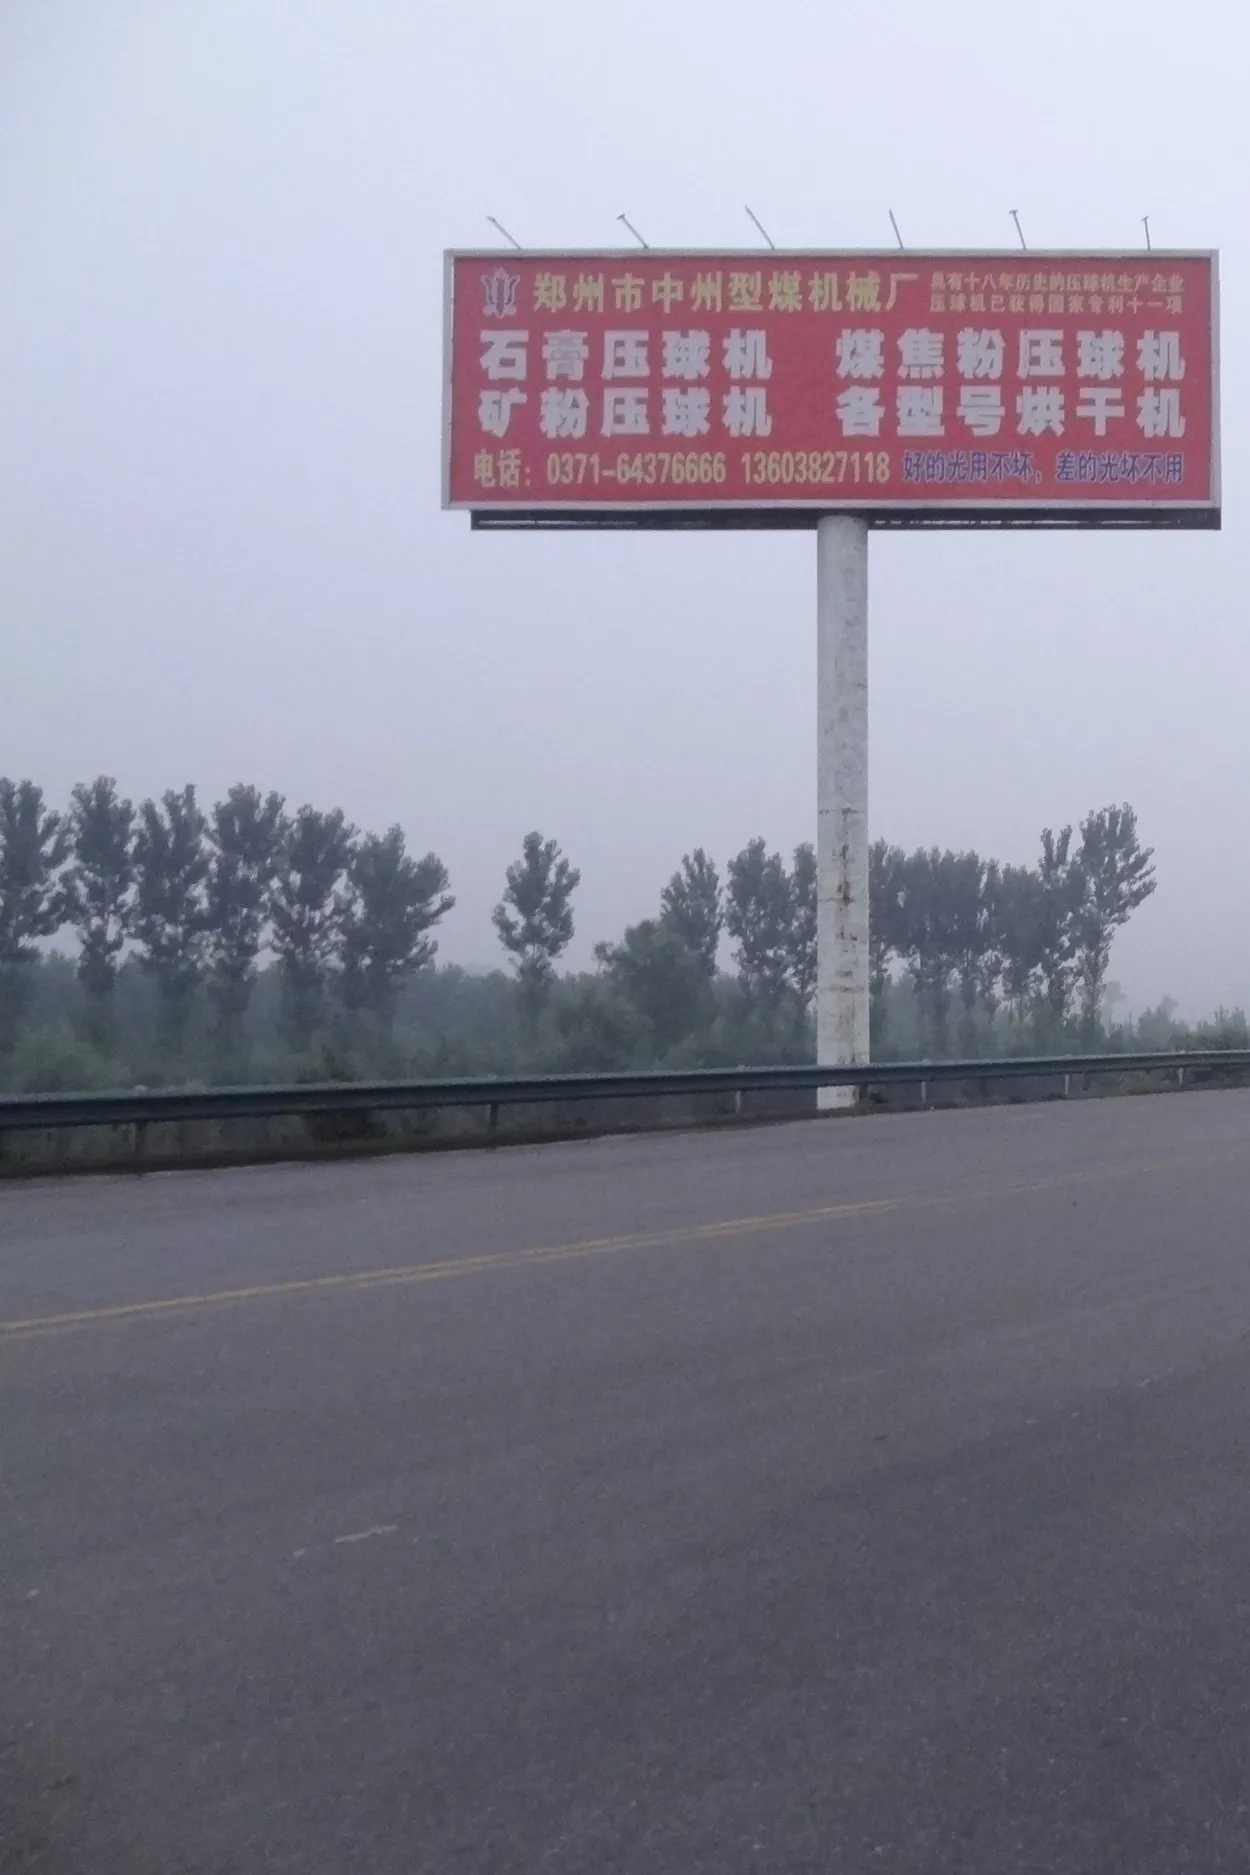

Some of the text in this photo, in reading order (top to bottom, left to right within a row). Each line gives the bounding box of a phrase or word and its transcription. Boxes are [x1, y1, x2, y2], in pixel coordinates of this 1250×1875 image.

[532, 271, 919, 314] 郑州市中州型煤机械厂
[479, 329, 1186, 380] 石膏压球机 煤焦粉压球机
[477, 386, 1186, 439] 矿粉压球机 各型号烘干机
[741, 451, 890, 484] 13603827118
